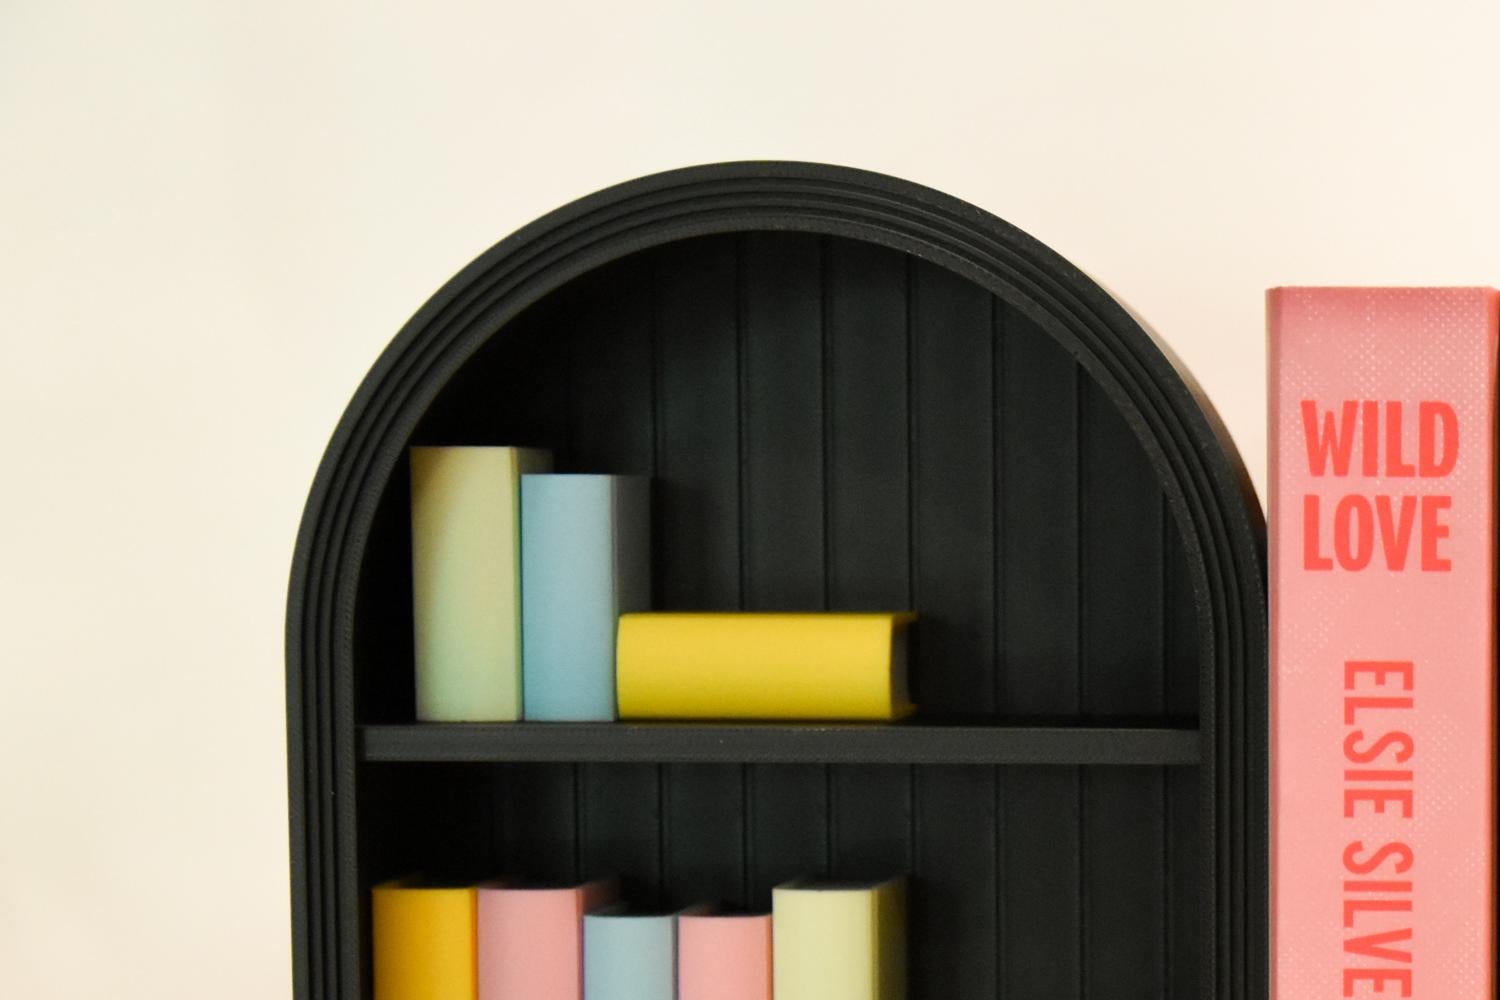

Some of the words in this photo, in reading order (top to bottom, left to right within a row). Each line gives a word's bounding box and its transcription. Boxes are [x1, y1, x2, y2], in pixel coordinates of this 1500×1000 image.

[1301, 400, 1460, 478] WILD
[1303, 494, 1452, 572] LOVE
[1342, 661, 1415, 818] ELSIE
